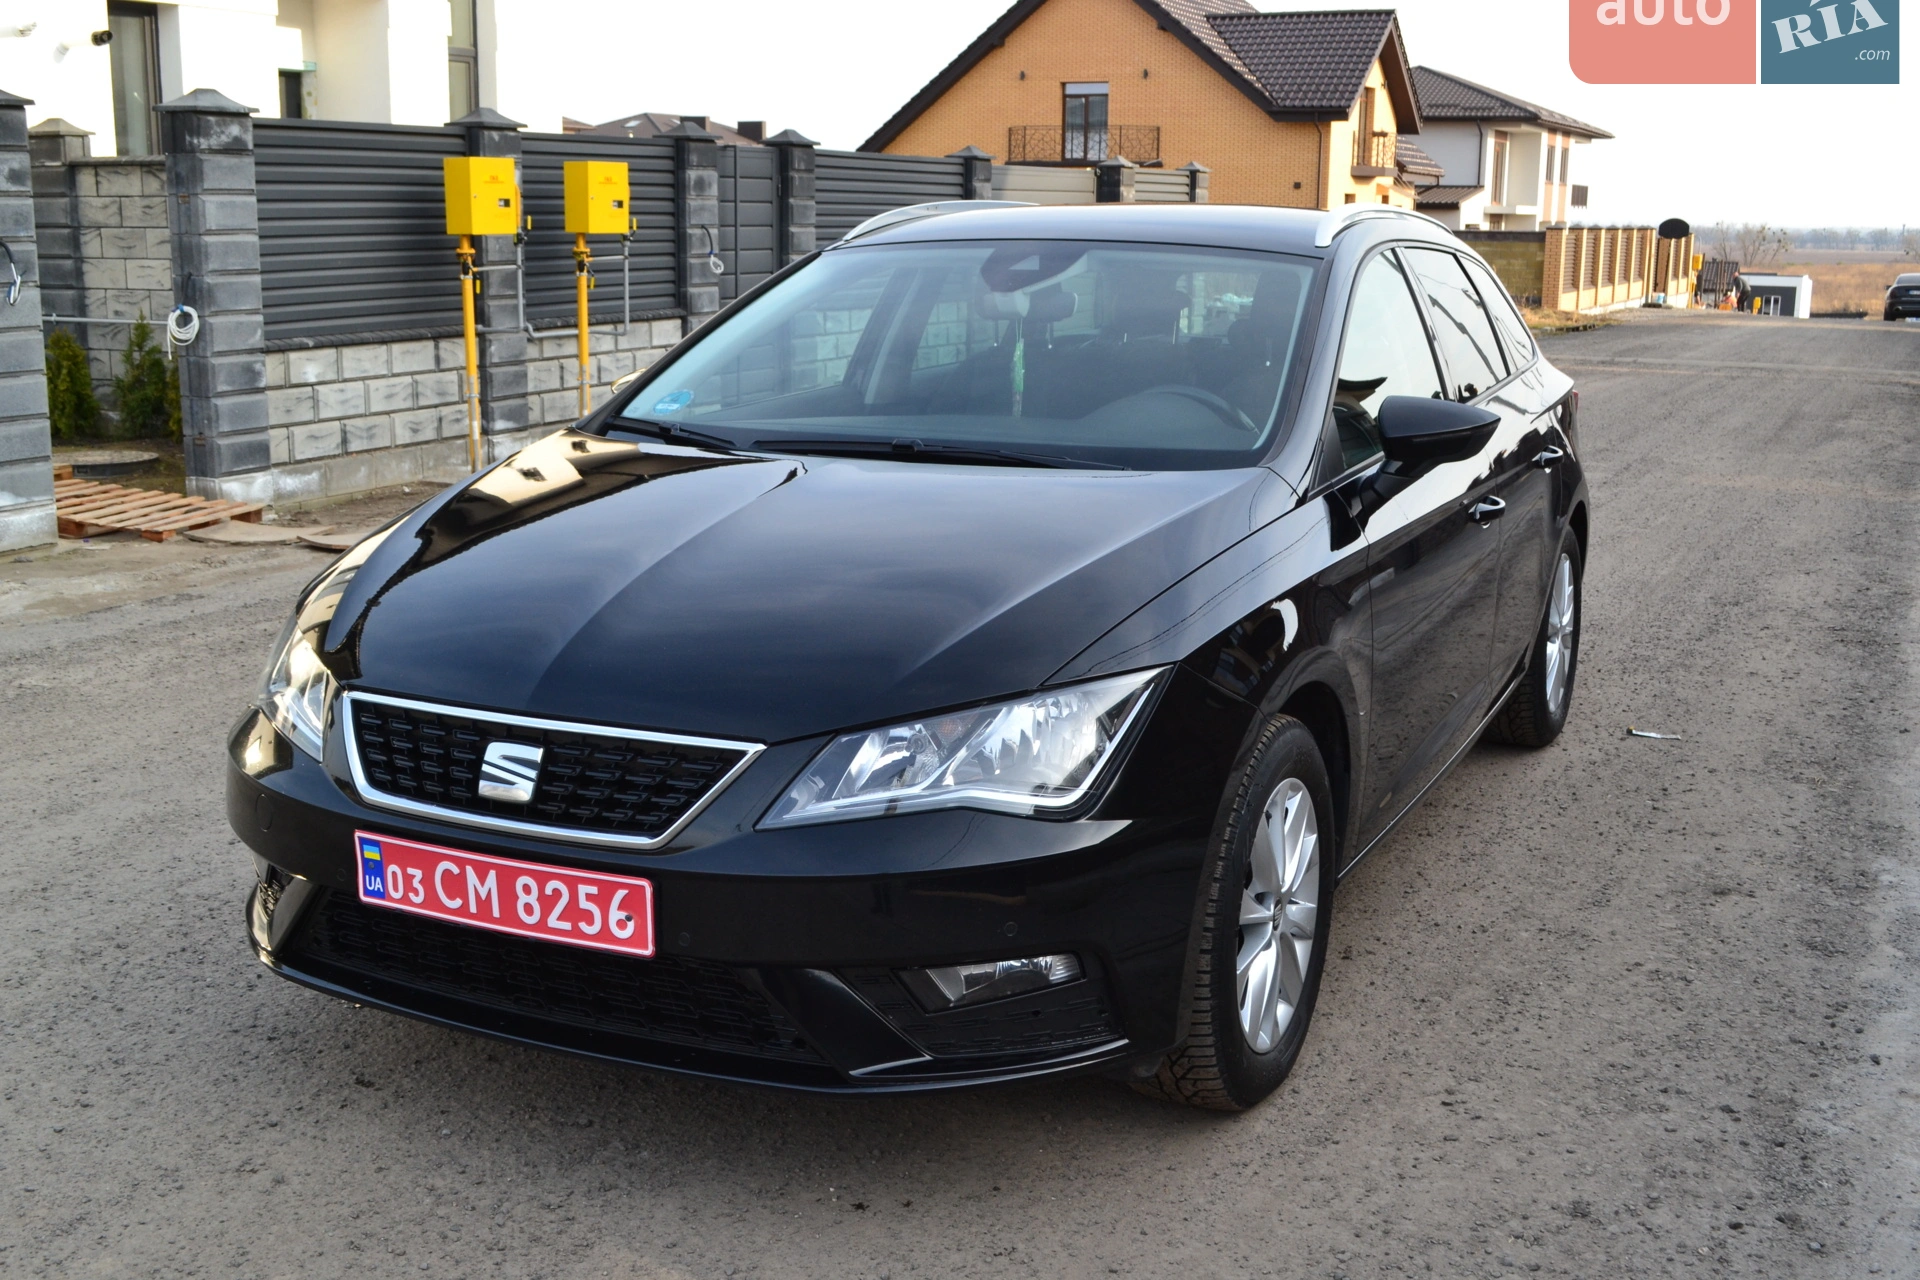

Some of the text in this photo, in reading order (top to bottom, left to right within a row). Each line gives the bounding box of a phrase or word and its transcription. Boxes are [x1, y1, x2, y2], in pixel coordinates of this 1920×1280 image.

[366, 875, 383, 893] UA
[387, 860, 635, 939] 03 CM 8256
